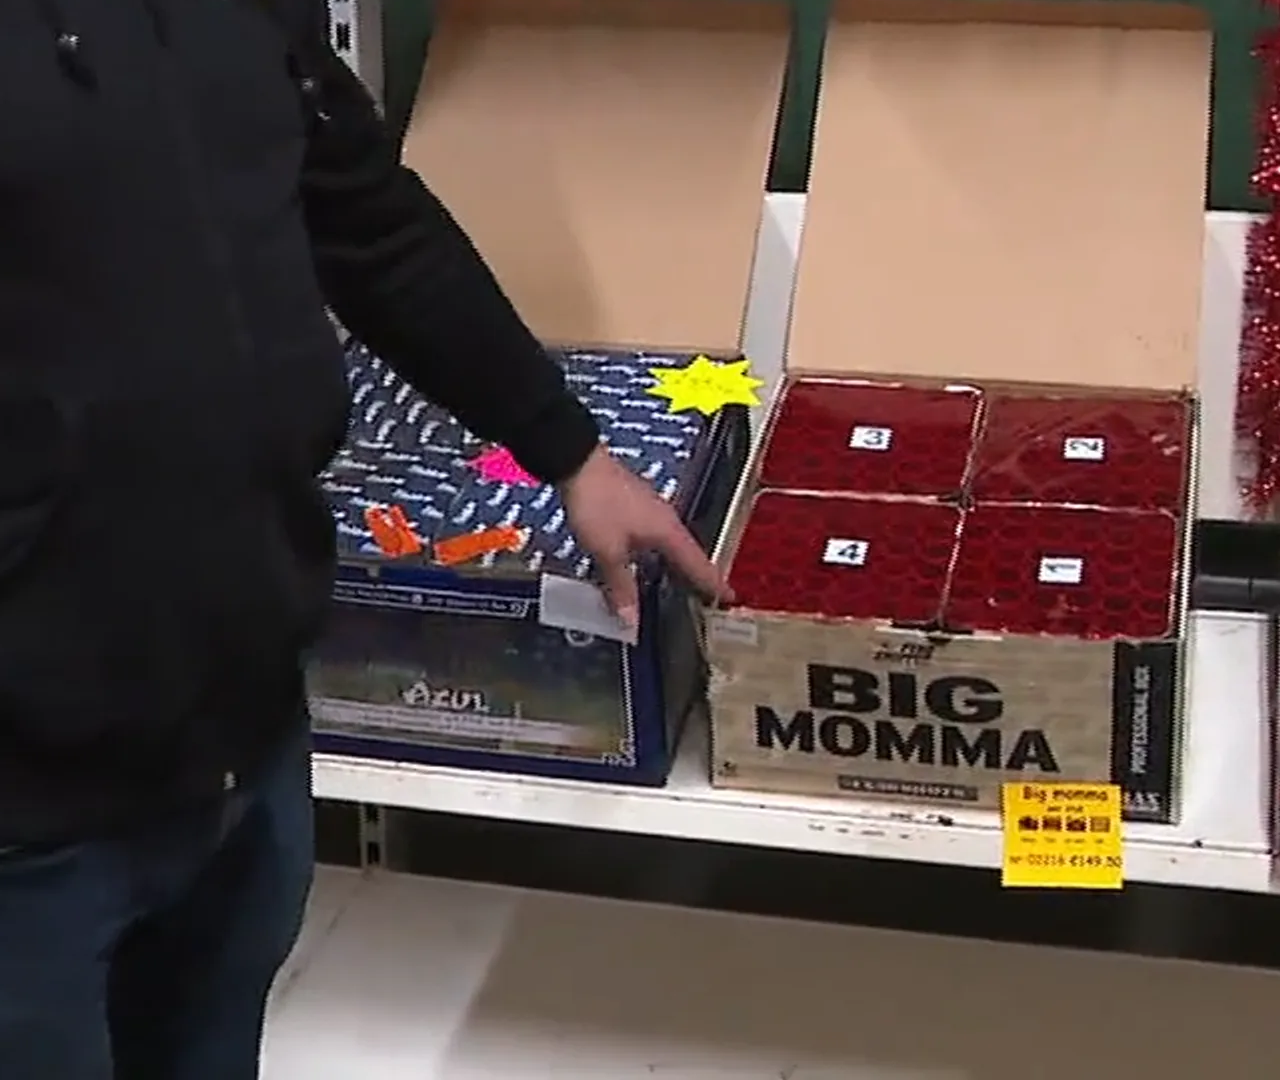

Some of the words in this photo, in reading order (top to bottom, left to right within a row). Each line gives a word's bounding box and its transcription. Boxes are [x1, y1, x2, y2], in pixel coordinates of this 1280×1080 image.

[863, 429, 886, 448] 3
[835, 542, 859, 563] 4
[807, 662, 1004, 724] BIG
[755, 704, 1061, 775] MOMMA
